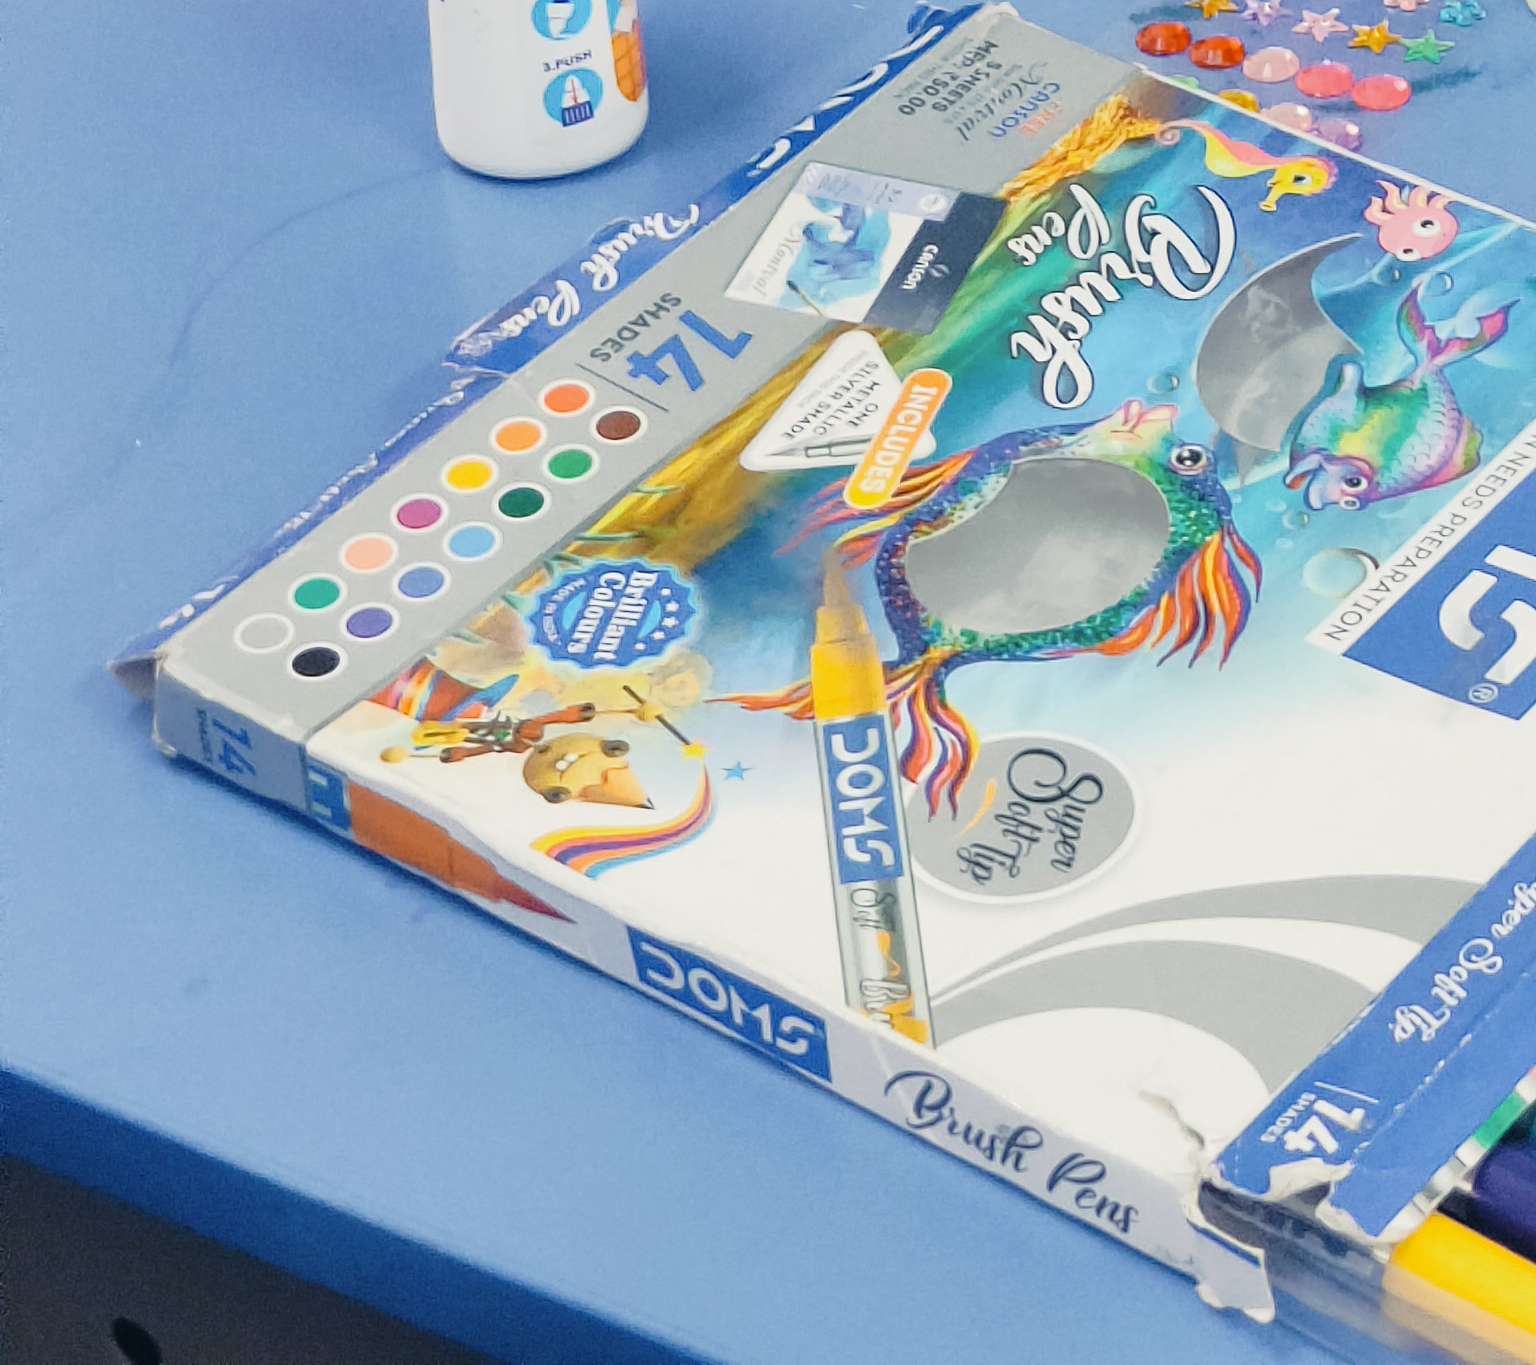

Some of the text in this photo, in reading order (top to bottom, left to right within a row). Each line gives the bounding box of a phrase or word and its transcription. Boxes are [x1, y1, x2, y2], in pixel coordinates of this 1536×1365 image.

[931, 68, 991, 113] SHEETS
[1006, 183, 1112, 267] Pens
[589, 291, 683, 363] SHADES
[1009, 184, 1238, 410] Brush
[625, 309, 753, 392] 14
[829, 360, 880, 401] SILVER
[780, 400, 832, 441] SHADE
[812, 379, 882, 437] METALLIC
[847, 403, 880, 429] ONE
[858, 383, 940, 495] INCLUDES
[1460, 449, 1532, 511] NEEDS
[1322, 511, 1468, 643] PREPARATION
[566, 571, 627, 654] Colours
[592, 570, 659, 661] Brilliant
[211, 717, 257, 777] 14
[829, 726, 896, 869] DOMS
[956, 839, 1023, 887] Tip
[639, 941, 816, 1057] DOMS
[1430, 937, 1504, 1007] Soft
[1388, 1003, 1451, 1043] Tip
[884, 1069, 1140, 1235] Brush Pens
[1259, 1091, 1317, 1144] SHADES
[1284, 1098, 1366, 1155] 14
